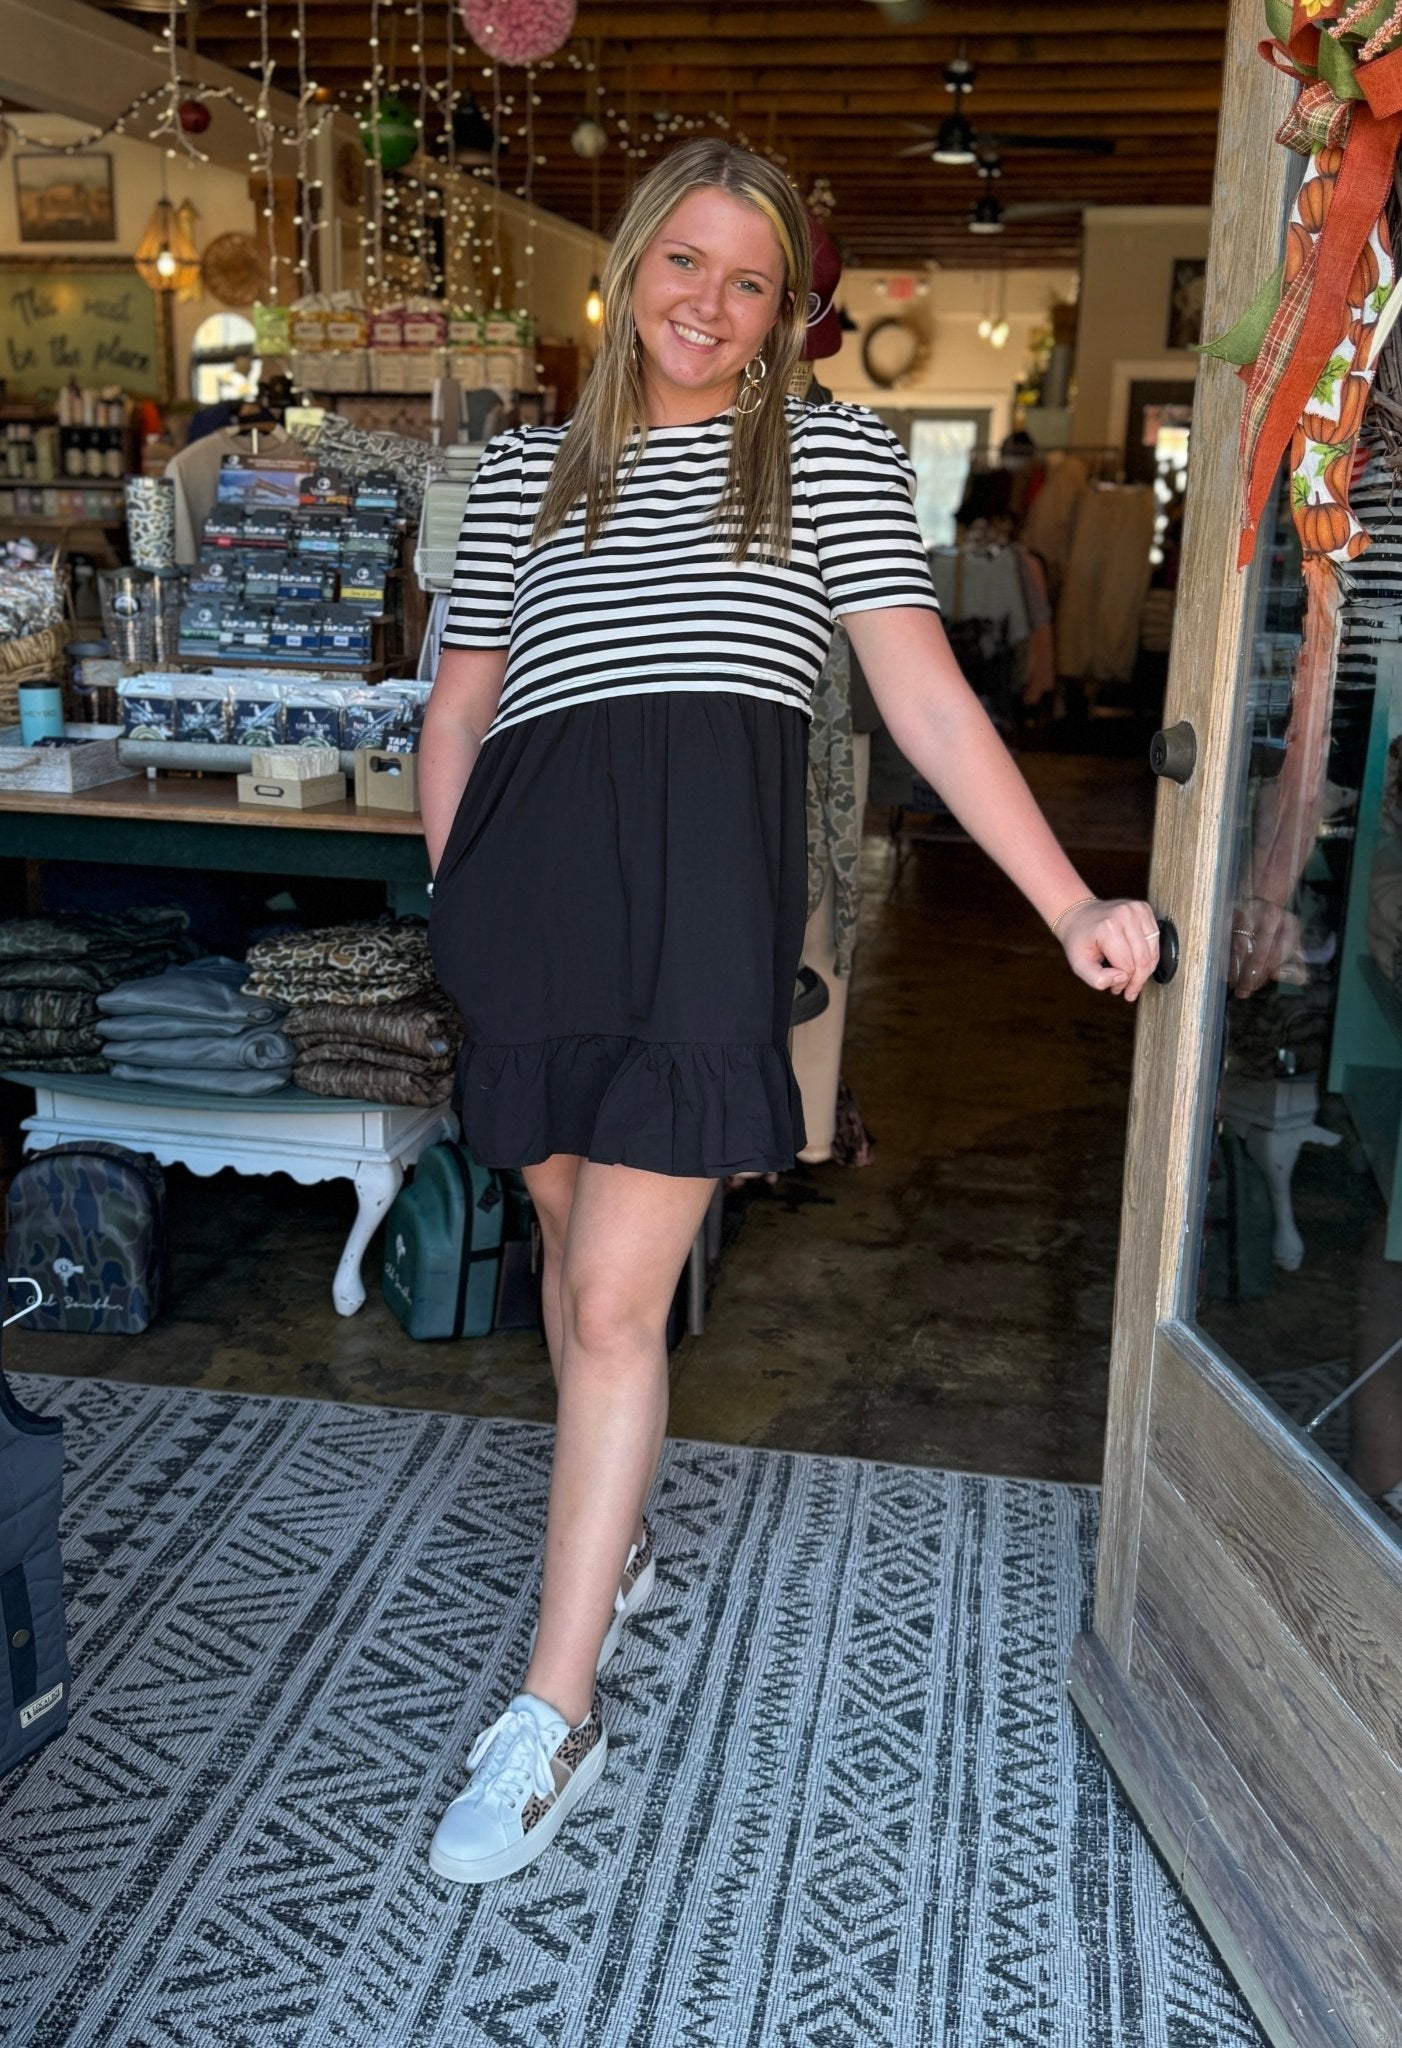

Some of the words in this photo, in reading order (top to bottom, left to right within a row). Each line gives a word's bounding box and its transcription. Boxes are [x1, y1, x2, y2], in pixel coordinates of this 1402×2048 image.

[295, 722, 316, 730] LOCAL
[388, 736, 407, 746] TAP
[26, 1293, 57, 1306] Od
